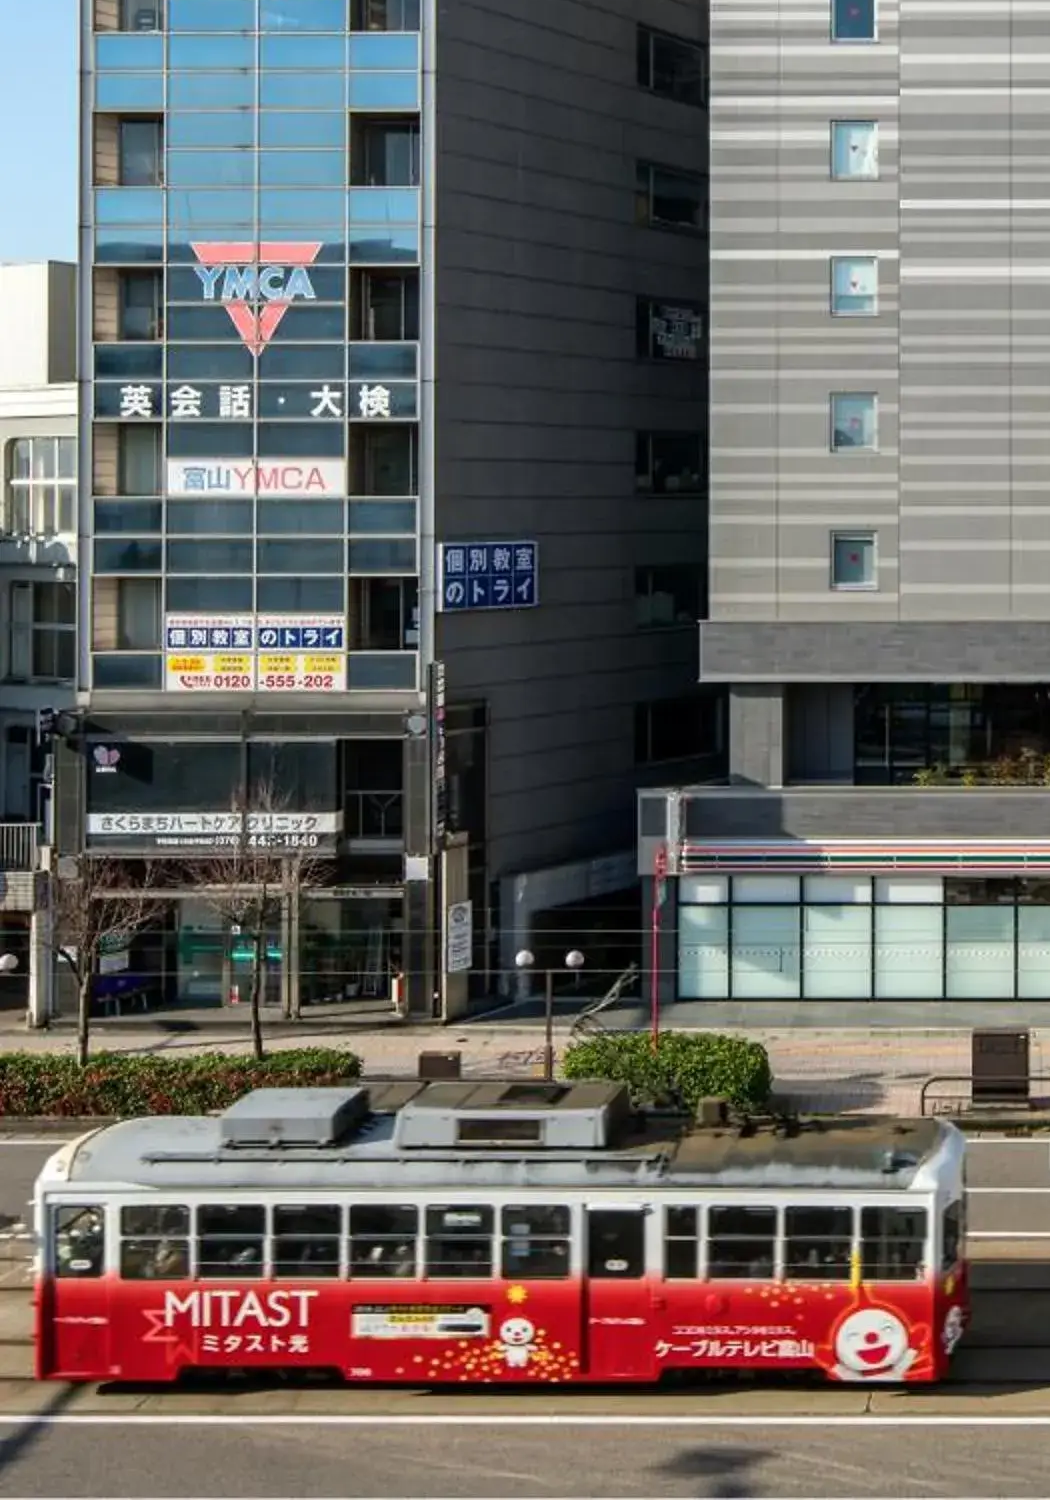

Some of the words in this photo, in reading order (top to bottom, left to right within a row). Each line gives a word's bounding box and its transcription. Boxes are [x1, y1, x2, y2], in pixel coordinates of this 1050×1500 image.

[195, 266, 316, 300] YMCA
[444, 548, 535, 575] 個別教室
[444, 578, 534, 604] のトライ
[164, 1290, 318, 1327] MITAST
[202, 1334, 309, 1353] ミタスト光
[655, 1338, 815, 1358] ケーブルテレビ富山
